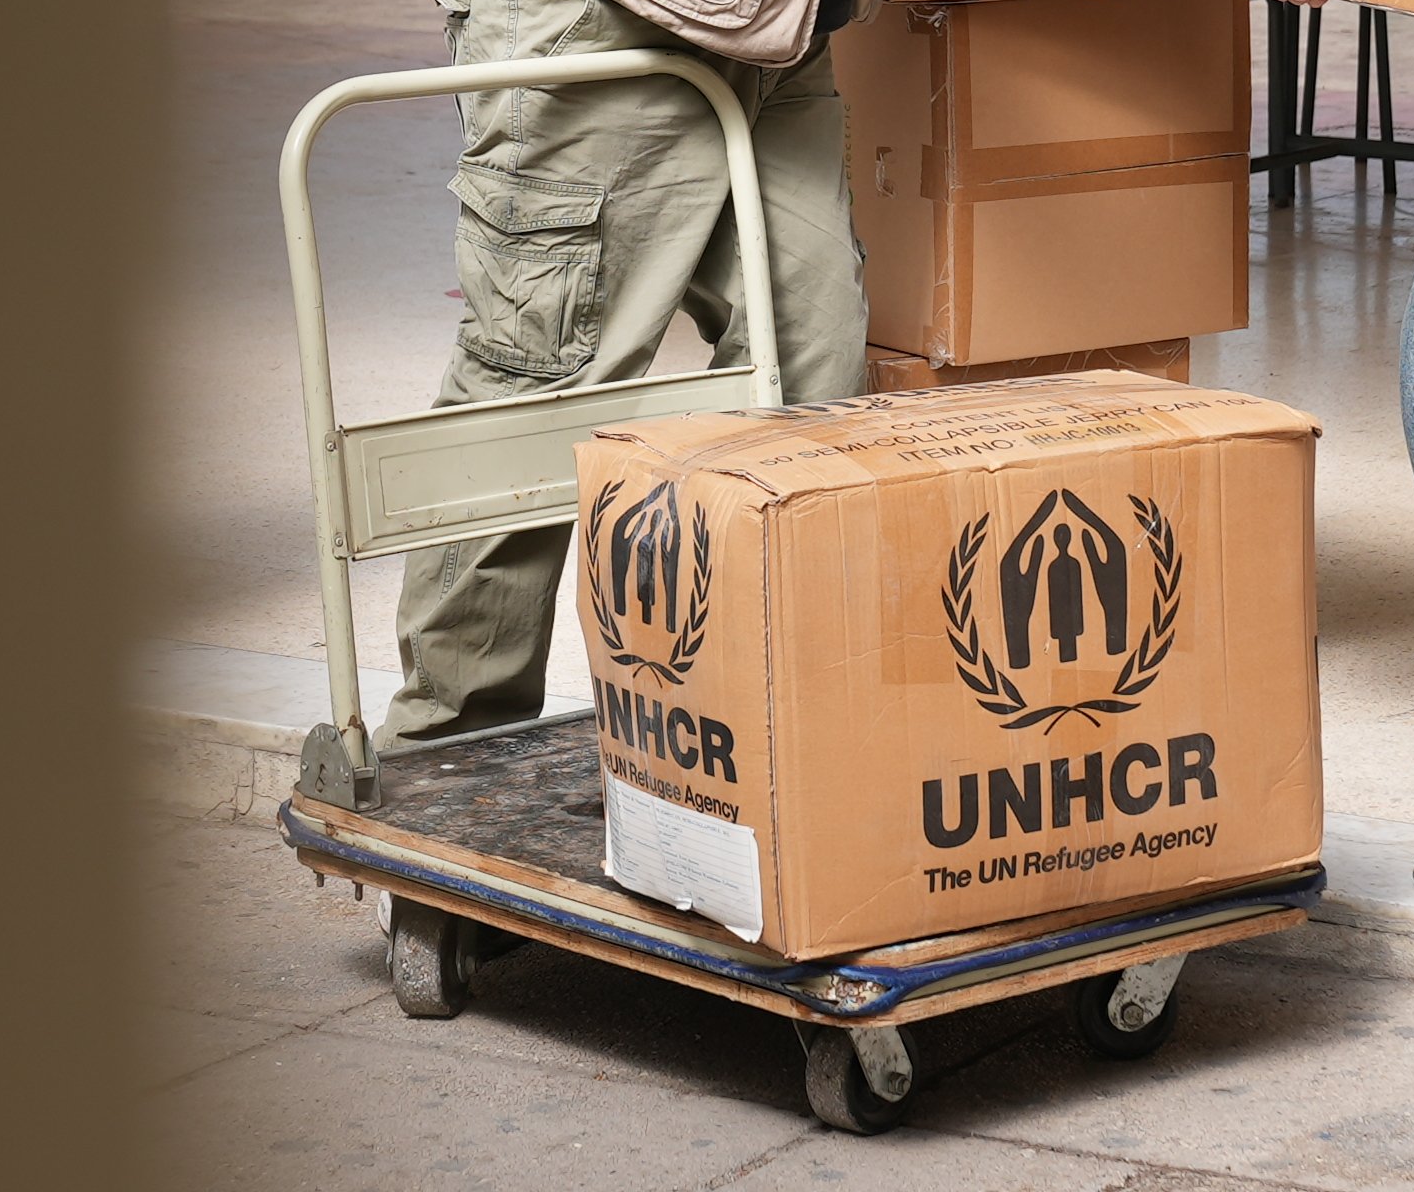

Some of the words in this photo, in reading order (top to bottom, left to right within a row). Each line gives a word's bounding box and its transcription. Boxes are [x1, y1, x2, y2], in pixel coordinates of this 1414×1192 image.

[759, 455, 793, 466] 50
[797, 417, 1059, 459] SEMI-COLLAPSIBLE
[1067, 407, 1145, 424] JERRY
[1153, 400, 1212, 412] CAN
[1215, 398, 1262, 406] 10L
[891, 410, 1019, 431] CONTENT
[1023, 403, 1079, 414] LIST
[897, 445, 969, 462] ITEM
[1023, 422, 1141, 445] HH-JC-10013
[609, 752, 627, 778] UN
[629, 760, 681, 801] Refugee
[684, 784, 740, 824] Agency
[922, 732, 1218, 848] UNHCR
[923, 867, 972, 893] The
[978, 855, 1017, 884] UN
[1023, 841, 1125, 876] Refugee
[1130, 822, 1218, 858] Agency
